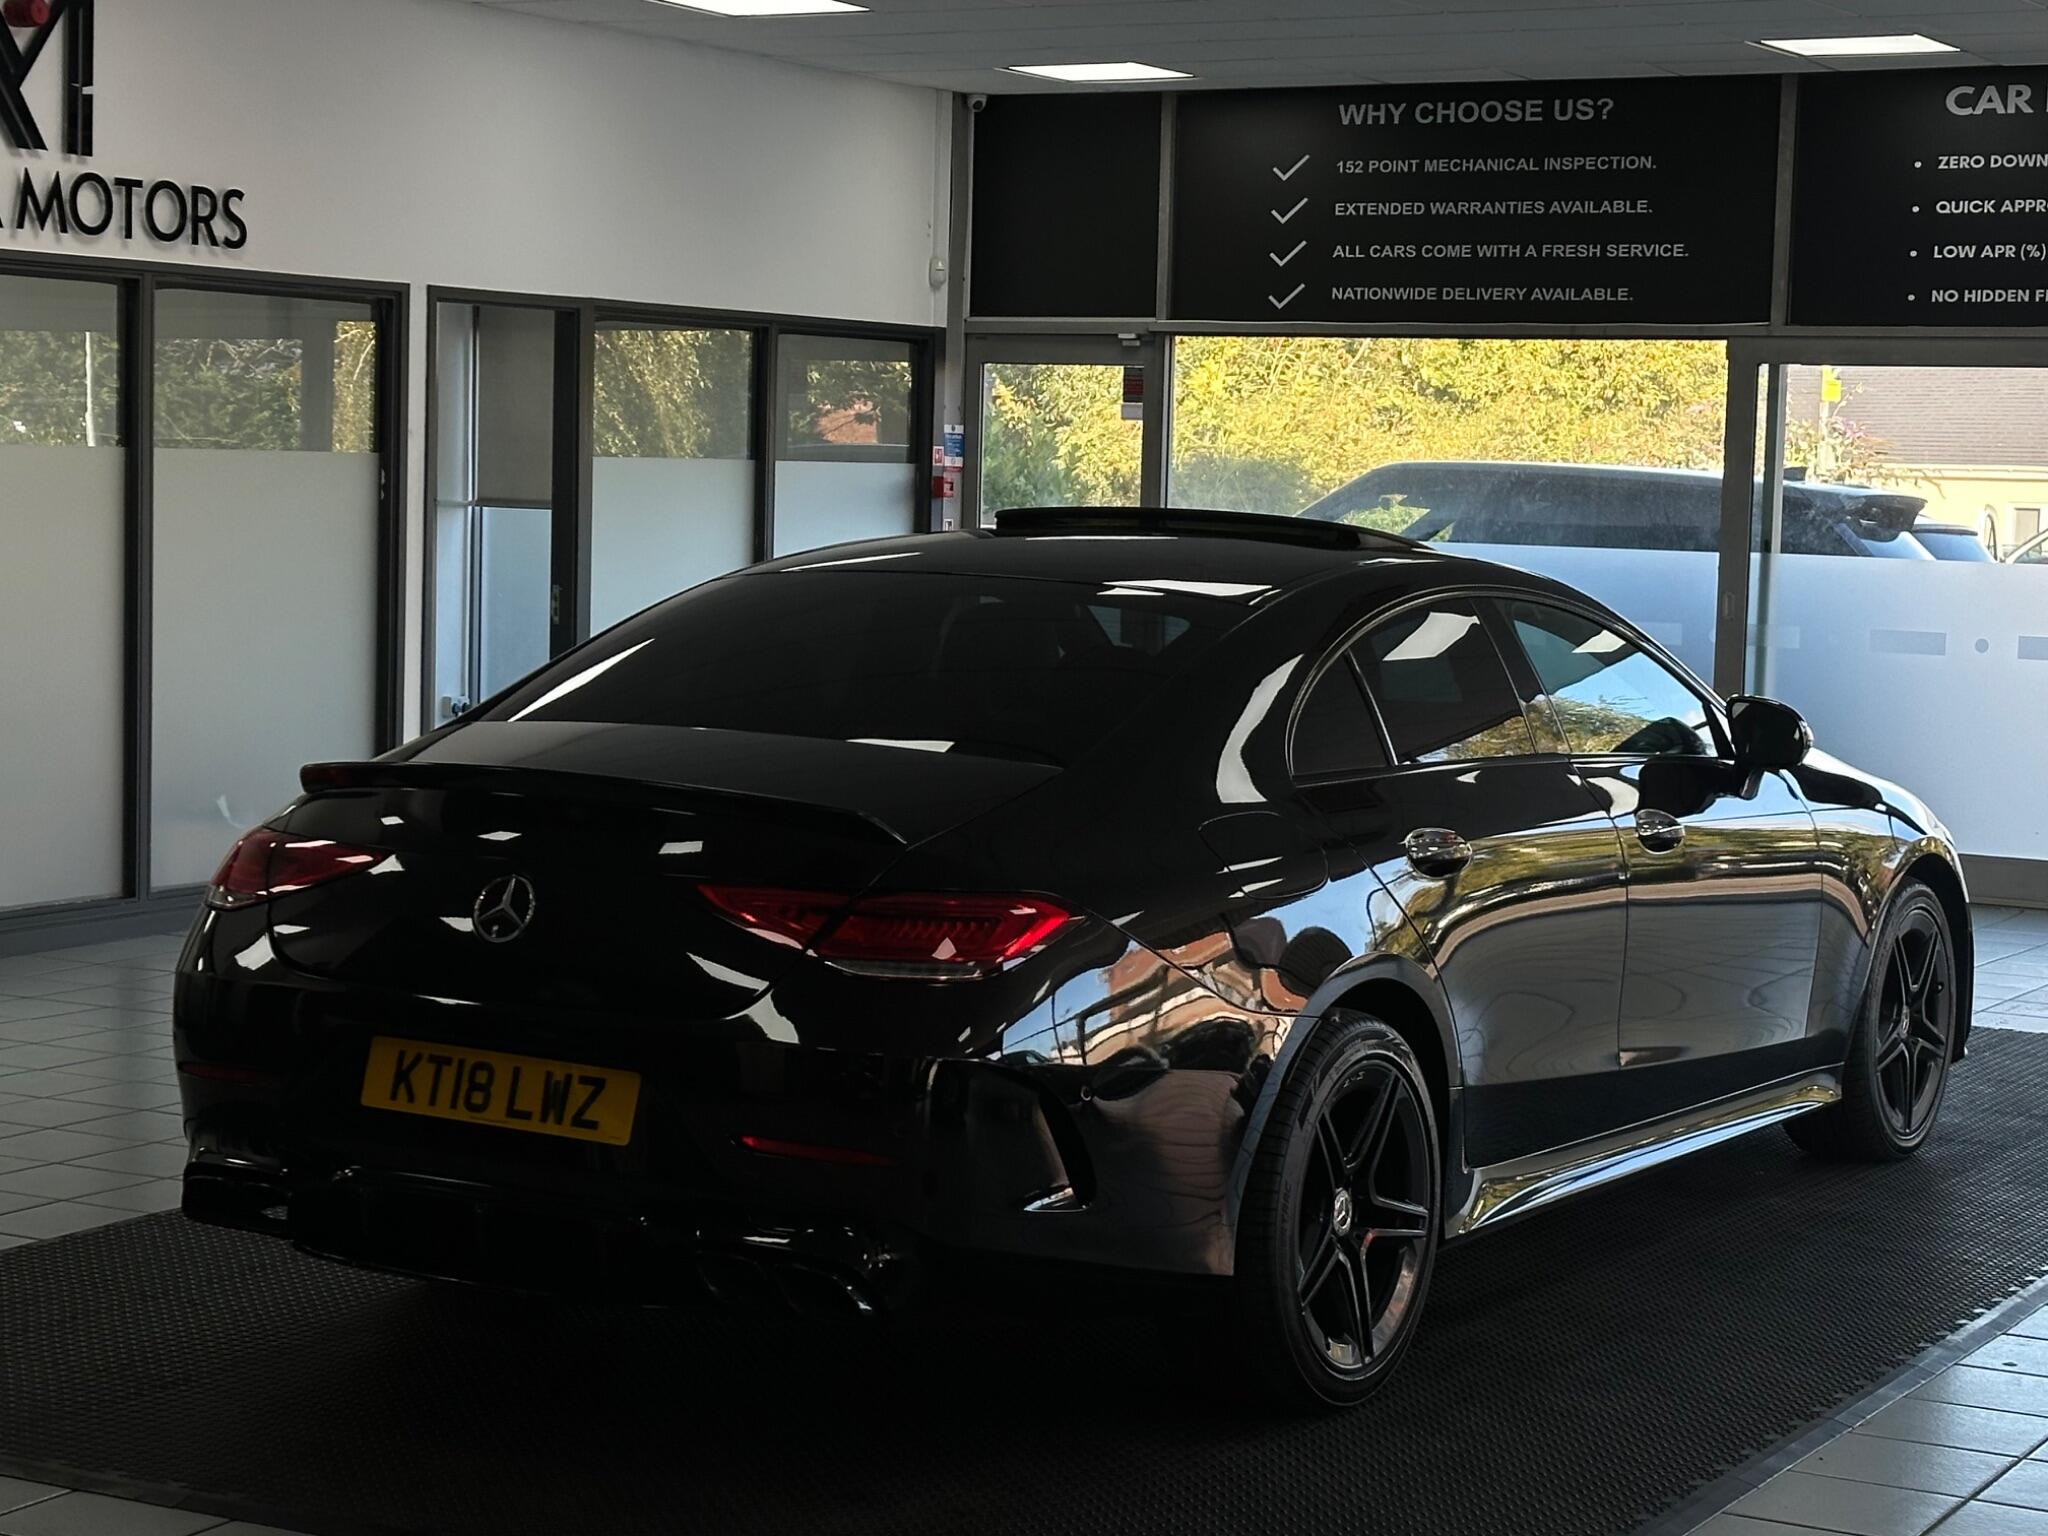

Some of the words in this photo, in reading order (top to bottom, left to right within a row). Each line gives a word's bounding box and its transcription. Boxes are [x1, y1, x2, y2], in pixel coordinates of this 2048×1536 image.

[1945, 84, 2034, 116] CAR
[1338, 103, 1407, 126] WHY
[1414, 99, 1543, 124] CHOOSE
[1554, 98, 1615, 121] US?
[1336, 160, 1364, 174] 152
[1368, 159, 1420, 173] POINT
[1424, 157, 1540, 173] MECHANICAL
[1544, 155, 1657, 171] INSPECTION.
[1938, 155, 1985, 169] ZERO
[1990, 153, 2048, 168] DOWN
[16, 167, 248, 250] MOTORS
[1334, 202, 1425, 216] EXTENDED
[1429, 200, 1545, 215] WARRANTIES
[1548, 199, 1653, 214] AVAILABLE.
[1936, 200, 1996, 214] QUICK
[2000, 199, 2048, 213] APPR
[1331, 244, 1366, 258] ALL
[1369, 244, 1417, 258] CARS
[1421, 244, 1472, 258] COME
[1476, 244, 1521, 258] WITH
[1524, 244, 1538, 258] A
[1541, 243, 1601, 258] FRESH
[1606, 243, 1689, 258] SERVICE.
[1933, 244, 1977, 258] LOW
[1980, 244, 2017, 258] APR
[2020, 243, 2047, 261] (%)
[1331, 287, 1438, 301] NATIONWIDE
[1442, 287, 1528, 301] DELIVERY
[1530, 286, 1634, 301] AVAILABLE.
[1931, 289, 1959, 303] NO
[1963, 289, 2030, 303] HIDDEN
[390, 1050, 495, 1114] KT18
[505, 1066, 606, 1131] LWZ
